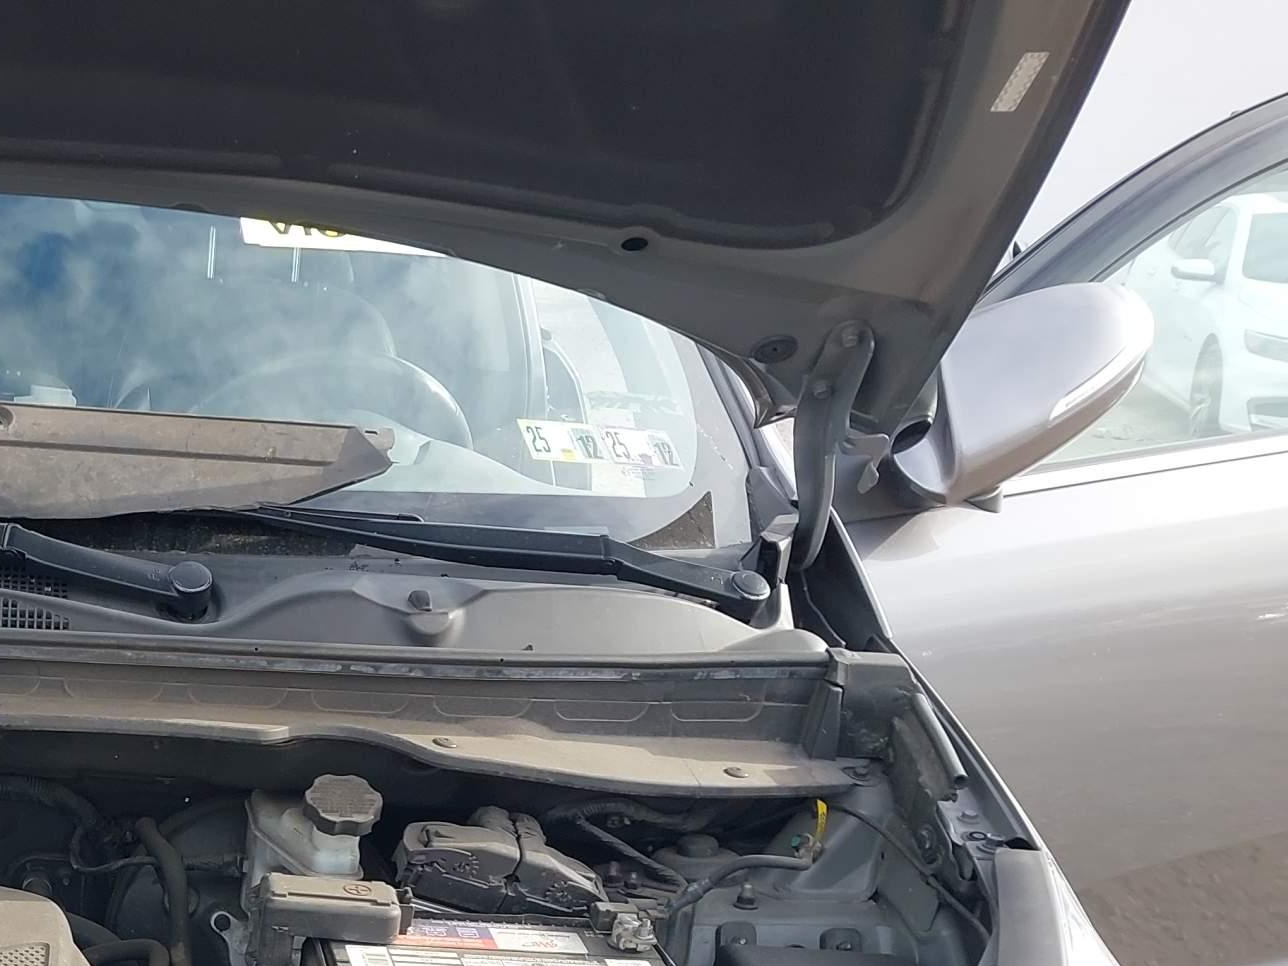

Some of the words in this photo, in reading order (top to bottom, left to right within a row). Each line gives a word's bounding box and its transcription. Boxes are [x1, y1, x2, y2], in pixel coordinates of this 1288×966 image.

[526, 426, 551, 452] 25
[576, 435, 605, 459] 12
[605, 431, 631, 459] 25
[654, 442, 680, 466] 12
